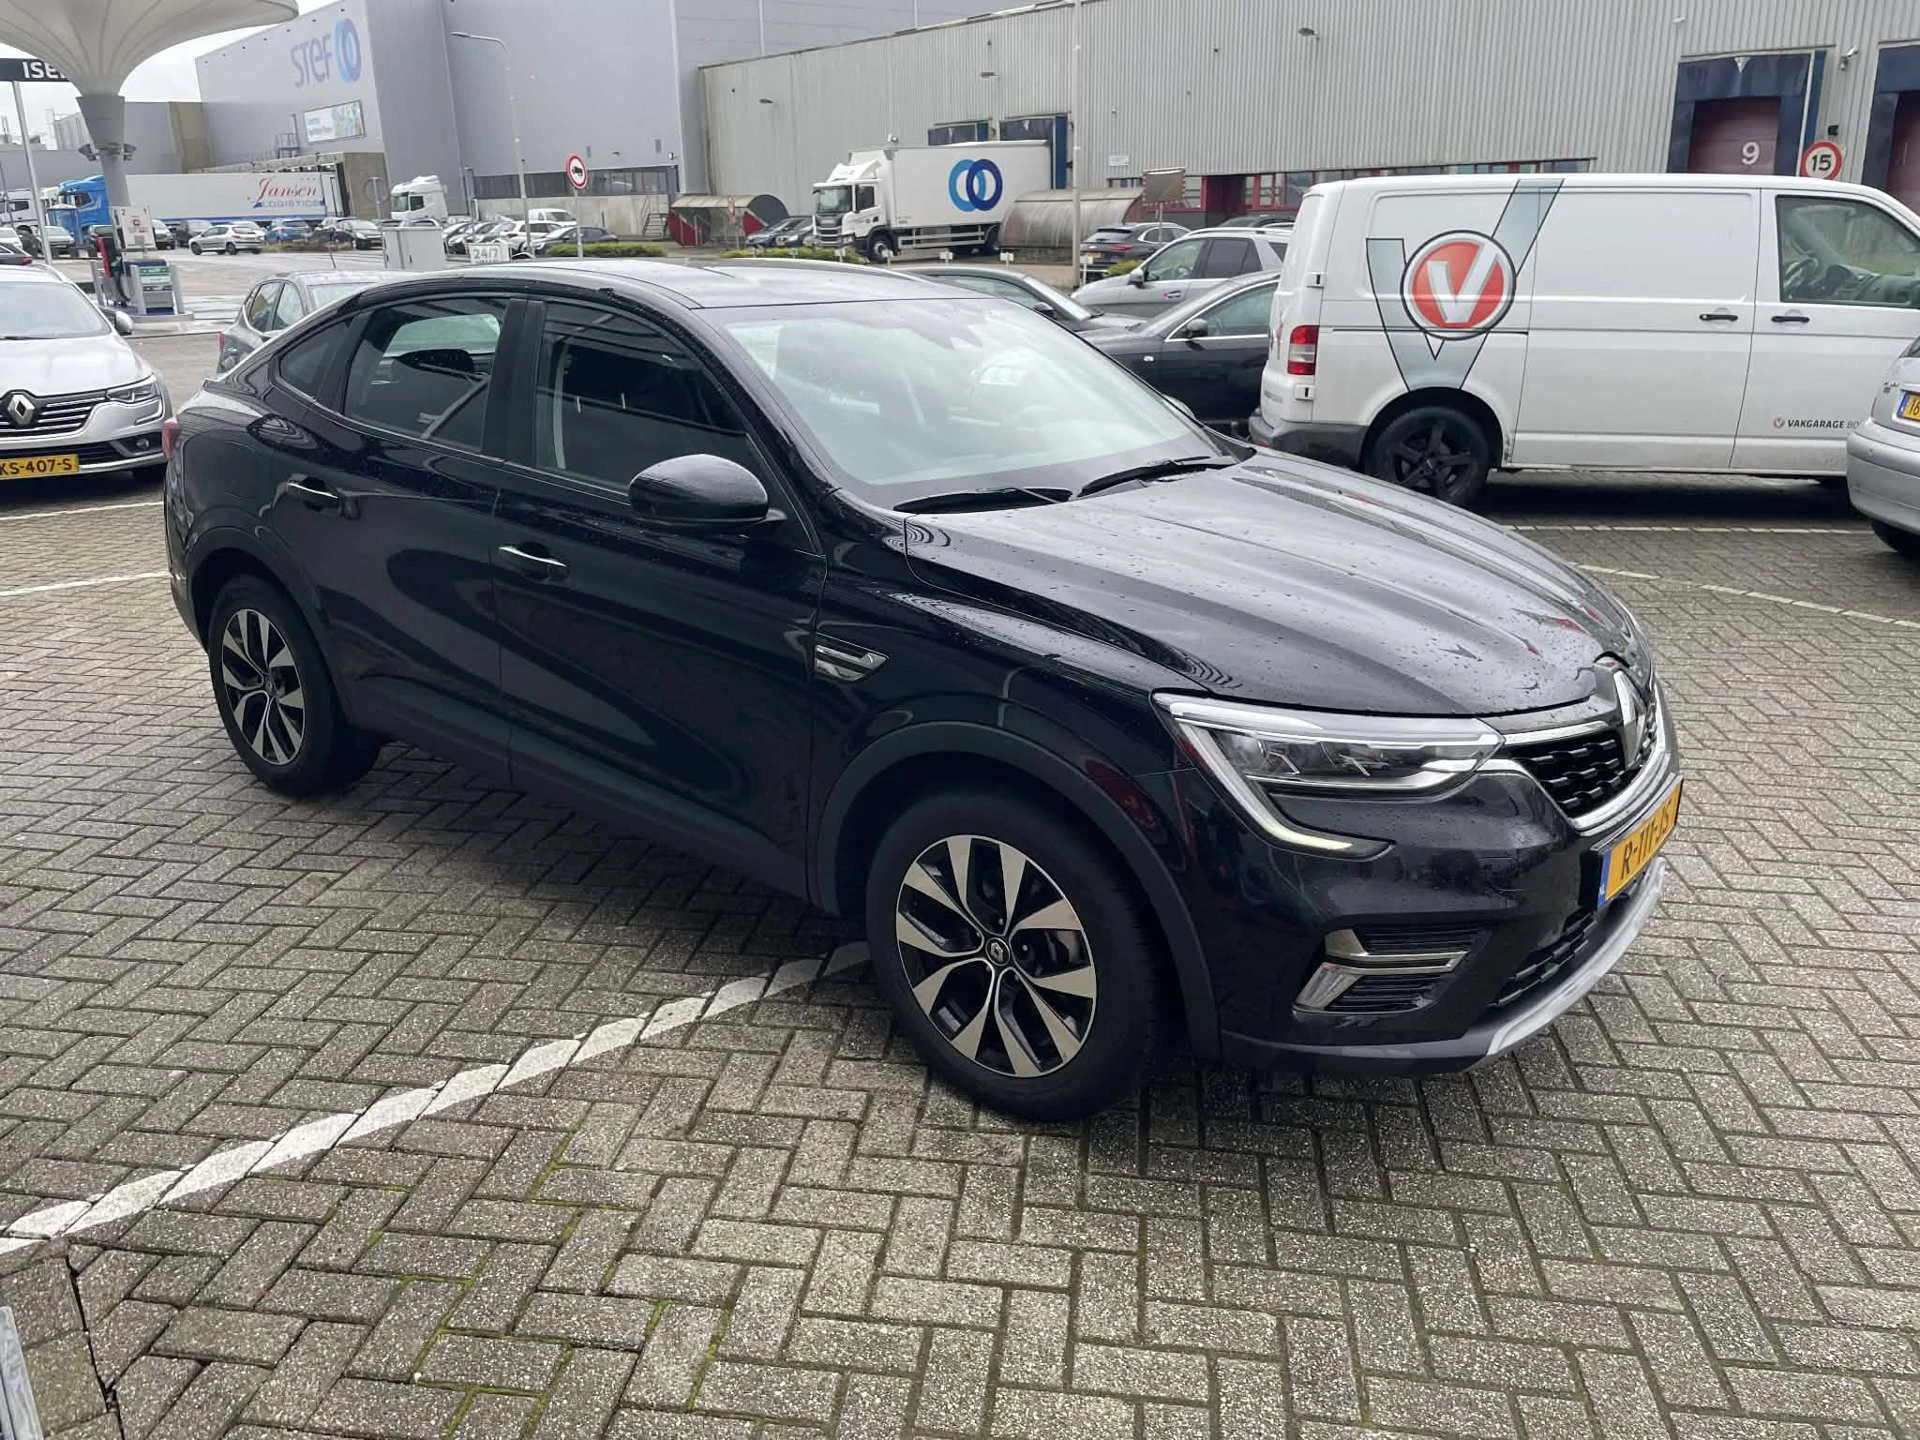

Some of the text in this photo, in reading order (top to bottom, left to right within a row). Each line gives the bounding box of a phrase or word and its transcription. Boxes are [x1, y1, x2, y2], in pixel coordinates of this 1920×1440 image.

[22, 61, 66, 79] ISE
[1742, 141, 1759, 165] 9
[1812, 154, 1832, 172] 15
[257, 178, 317, 202] Jansen
[1787, 419, 1845, 429] VAKGARAGE
[0, 458, 73, 475] KS-407-S
